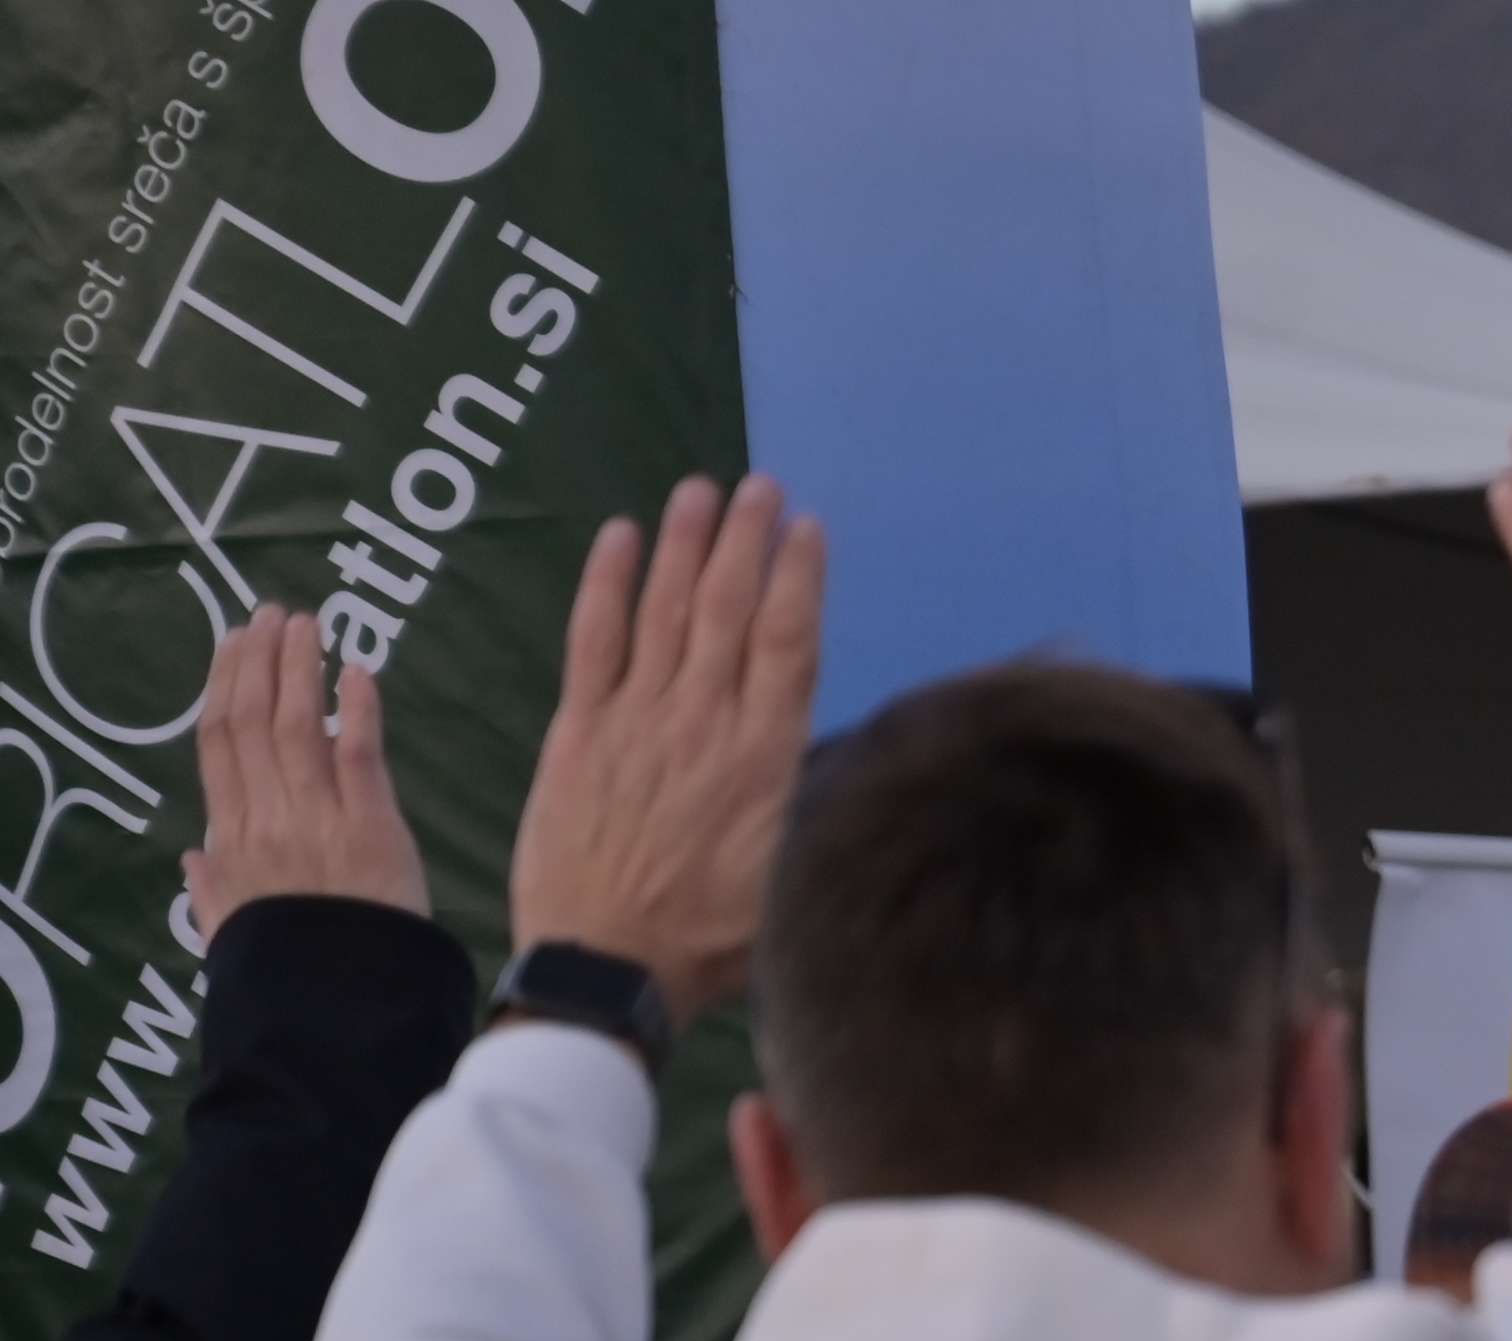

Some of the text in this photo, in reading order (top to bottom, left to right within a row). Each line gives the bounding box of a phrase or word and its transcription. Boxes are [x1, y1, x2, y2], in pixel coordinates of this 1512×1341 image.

[187, 50, 229, 89] s
[199, 0, 274, 42] š
[107, 97, 208, 255] sreča
[0, 0, 594, 1210] RICATLO
